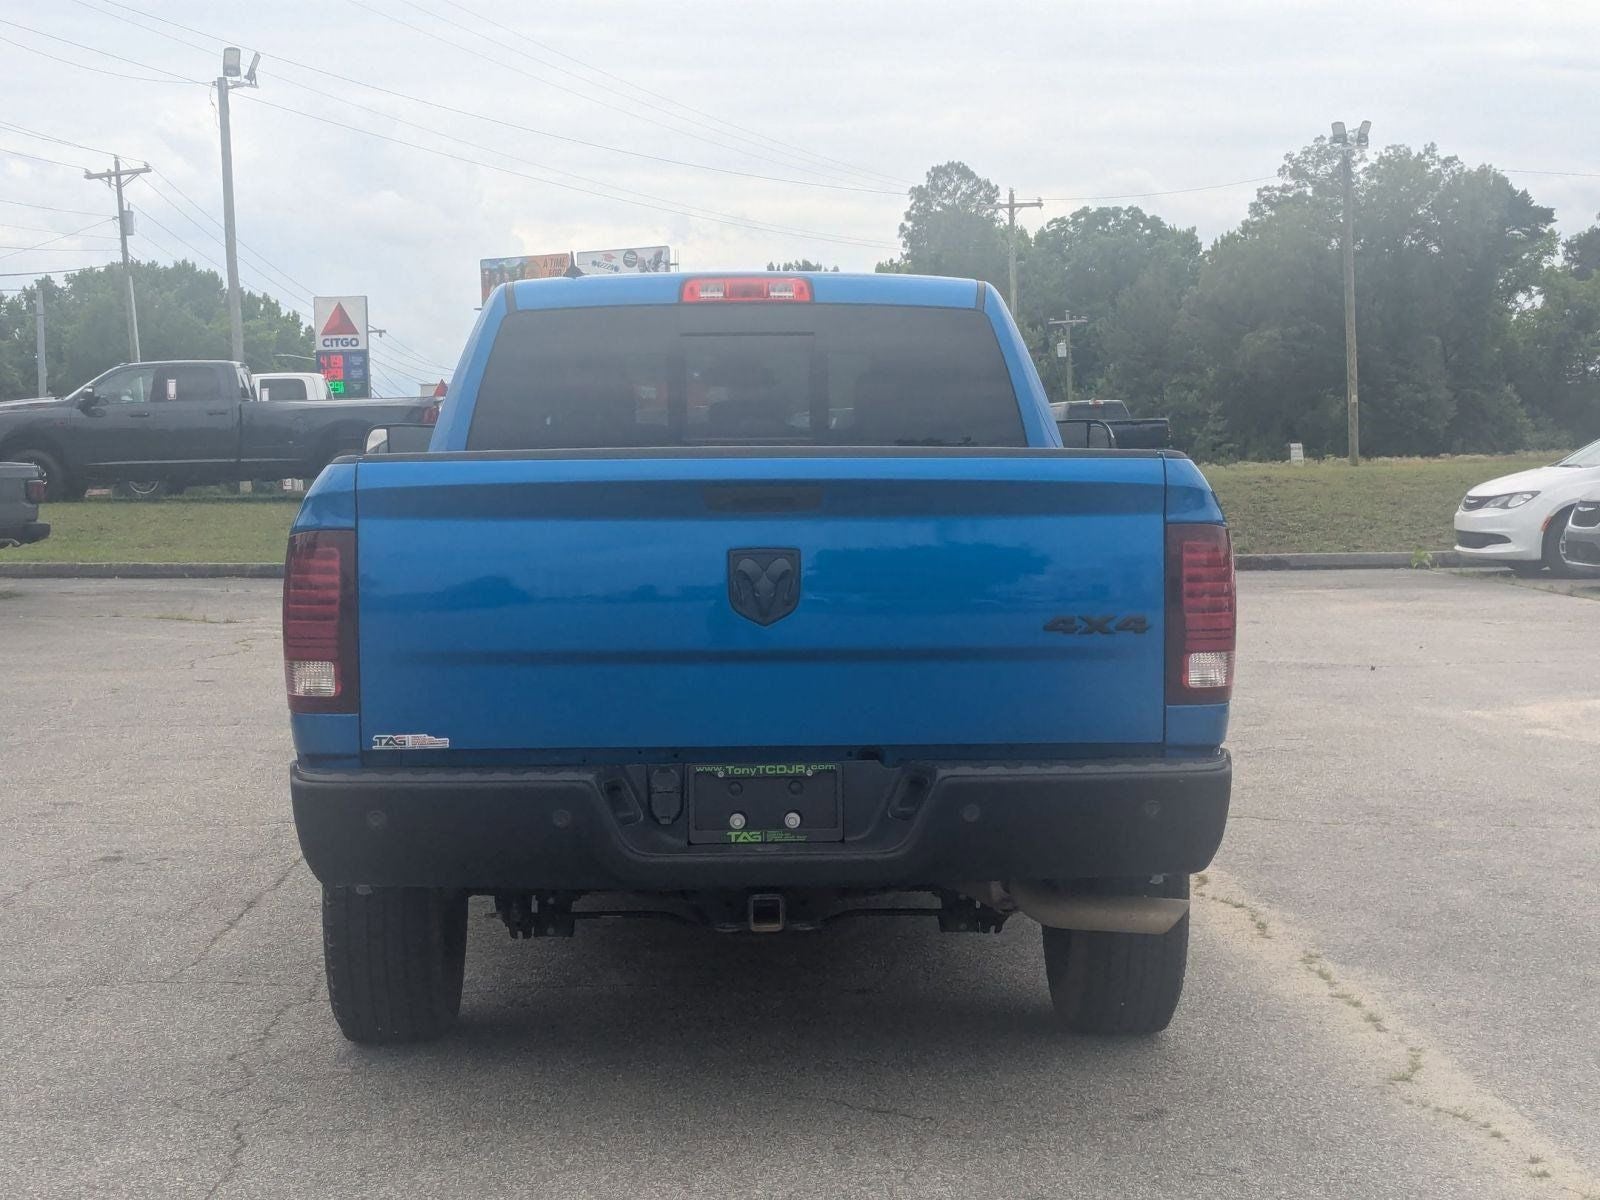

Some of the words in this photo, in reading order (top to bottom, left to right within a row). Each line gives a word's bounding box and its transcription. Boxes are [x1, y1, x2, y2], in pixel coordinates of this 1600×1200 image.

[322, 337, 360, 348] CITGO
[374, 735, 406, 747] TAG
[727, 831, 761, 843] TAG
